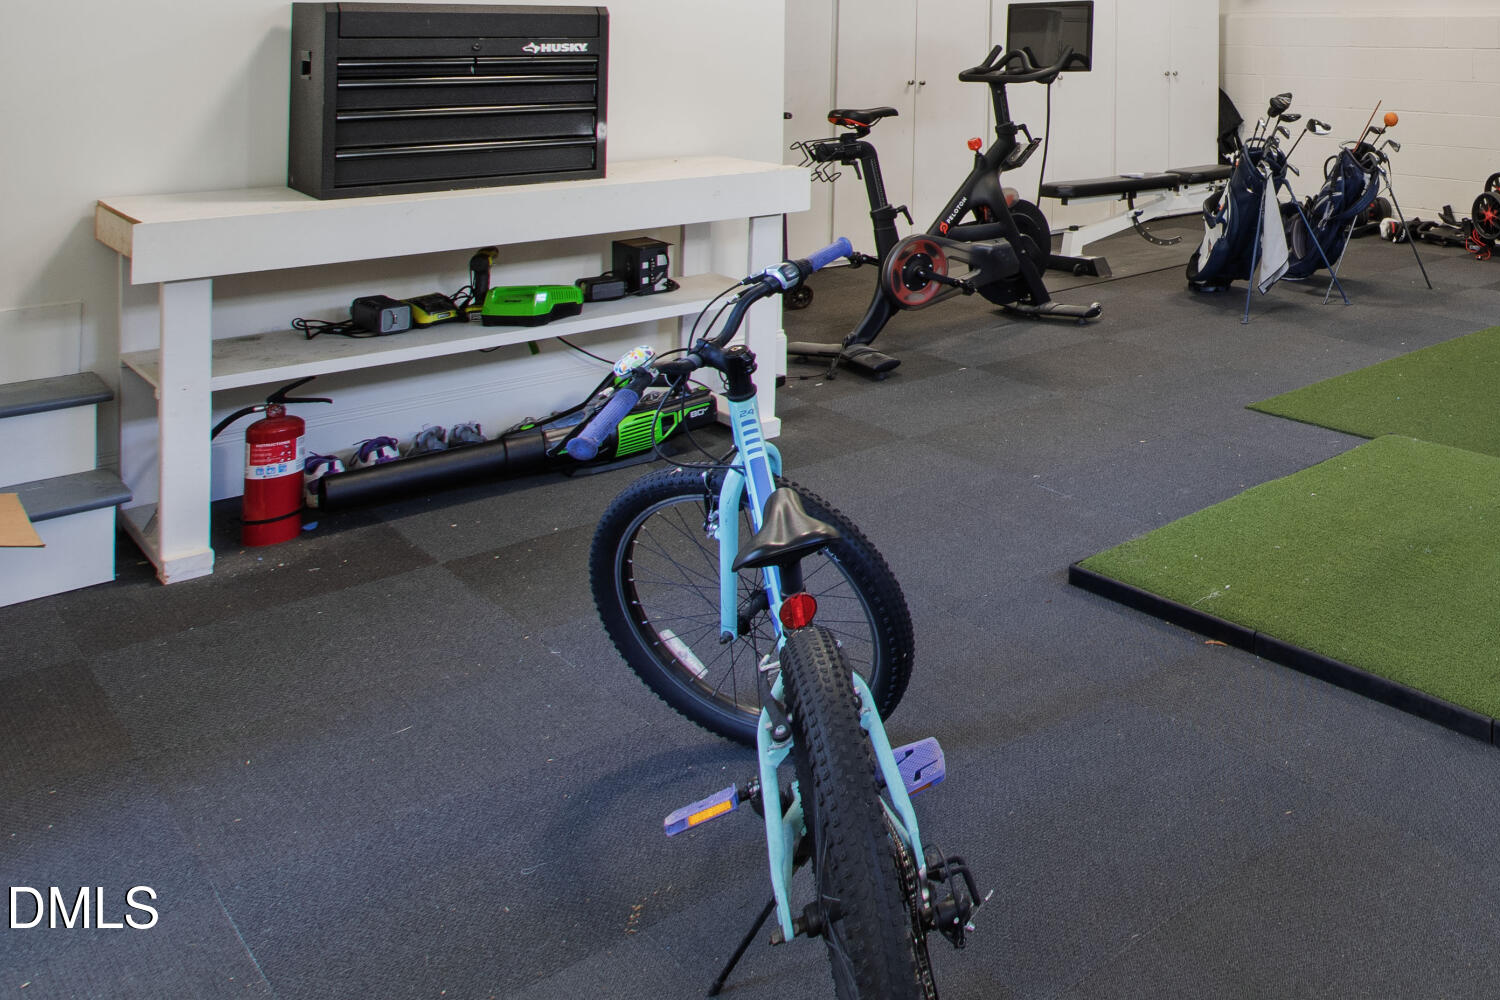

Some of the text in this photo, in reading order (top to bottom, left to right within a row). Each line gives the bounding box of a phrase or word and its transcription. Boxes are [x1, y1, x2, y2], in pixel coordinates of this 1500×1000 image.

[540, 43, 588, 52] HUSKY
[946, 197, 968, 224] PELOTON
[740, 408, 755, 418] 24
